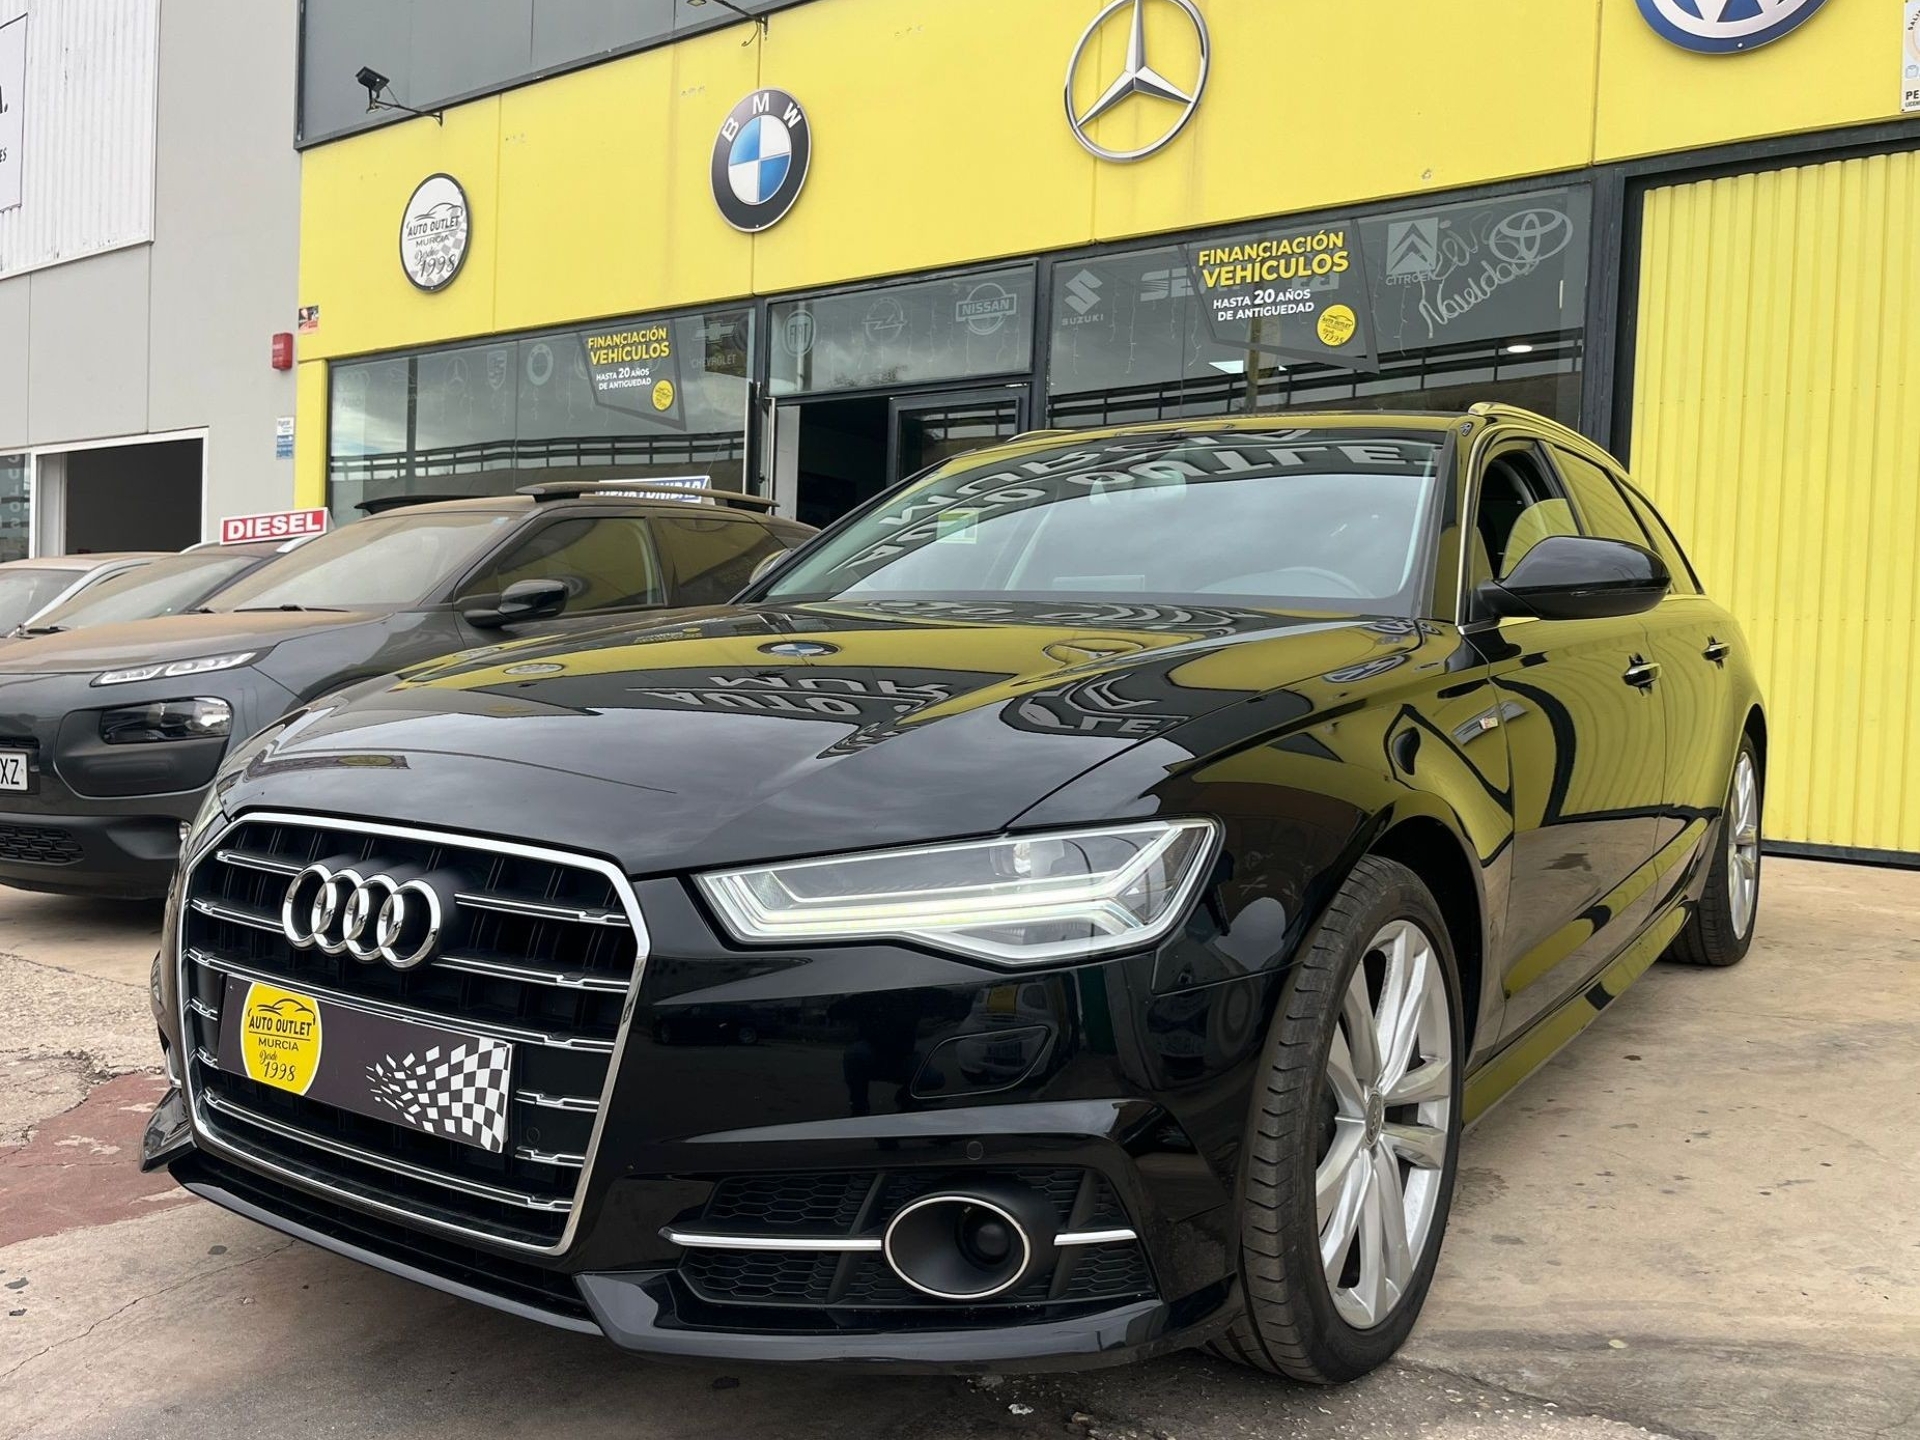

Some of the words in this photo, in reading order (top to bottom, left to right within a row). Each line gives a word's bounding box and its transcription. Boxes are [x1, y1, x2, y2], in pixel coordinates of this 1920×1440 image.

[721, 92, 803, 143] BMW
[407, 222, 428, 237] AUTO
[429, 215, 460, 232] OUTLET
[416, 234, 450, 249] MURCIA
[1198, 230, 1344, 267] FINANCIACIÓN
[420, 254, 456, 278] 1998
[1202, 250, 1349, 289] VEHÍCULOS
[961, 298, 1010, 316] NISSAN
[1213, 296, 1251, 310] HASTA
[1253, 289, 1275, 305] 20
[1276, 288, 1311, 303] AÑOS
[1062, 313, 1104, 326] SUZUKI
[1217, 310, 1234, 322] DE
[1236, 302, 1315, 320] ANTIGUEDAD
[588, 325, 667, 349] FINANCIACIÓN
[590, 341, 670, 366] VEHÍCULOS
[690, 354, 737, 369] CHEVROLET
[596, 371, 618, 381] HASTA
[618, 367, 631, 379] 20
[631, 367, 650, 378] AÑOS
[598, 382, 609, 391] DE
[608, 377, 651, 389] ANTIGUEDAD
[227, 512, 321, 541] DIESEL
[249, 1015, 274, 1031] AUTO
[275, 1018, 312, 1036] OUTLET
[258, 1037, 299, 1051] MURCIA
[264, 1060, 296, 1082] 1998
